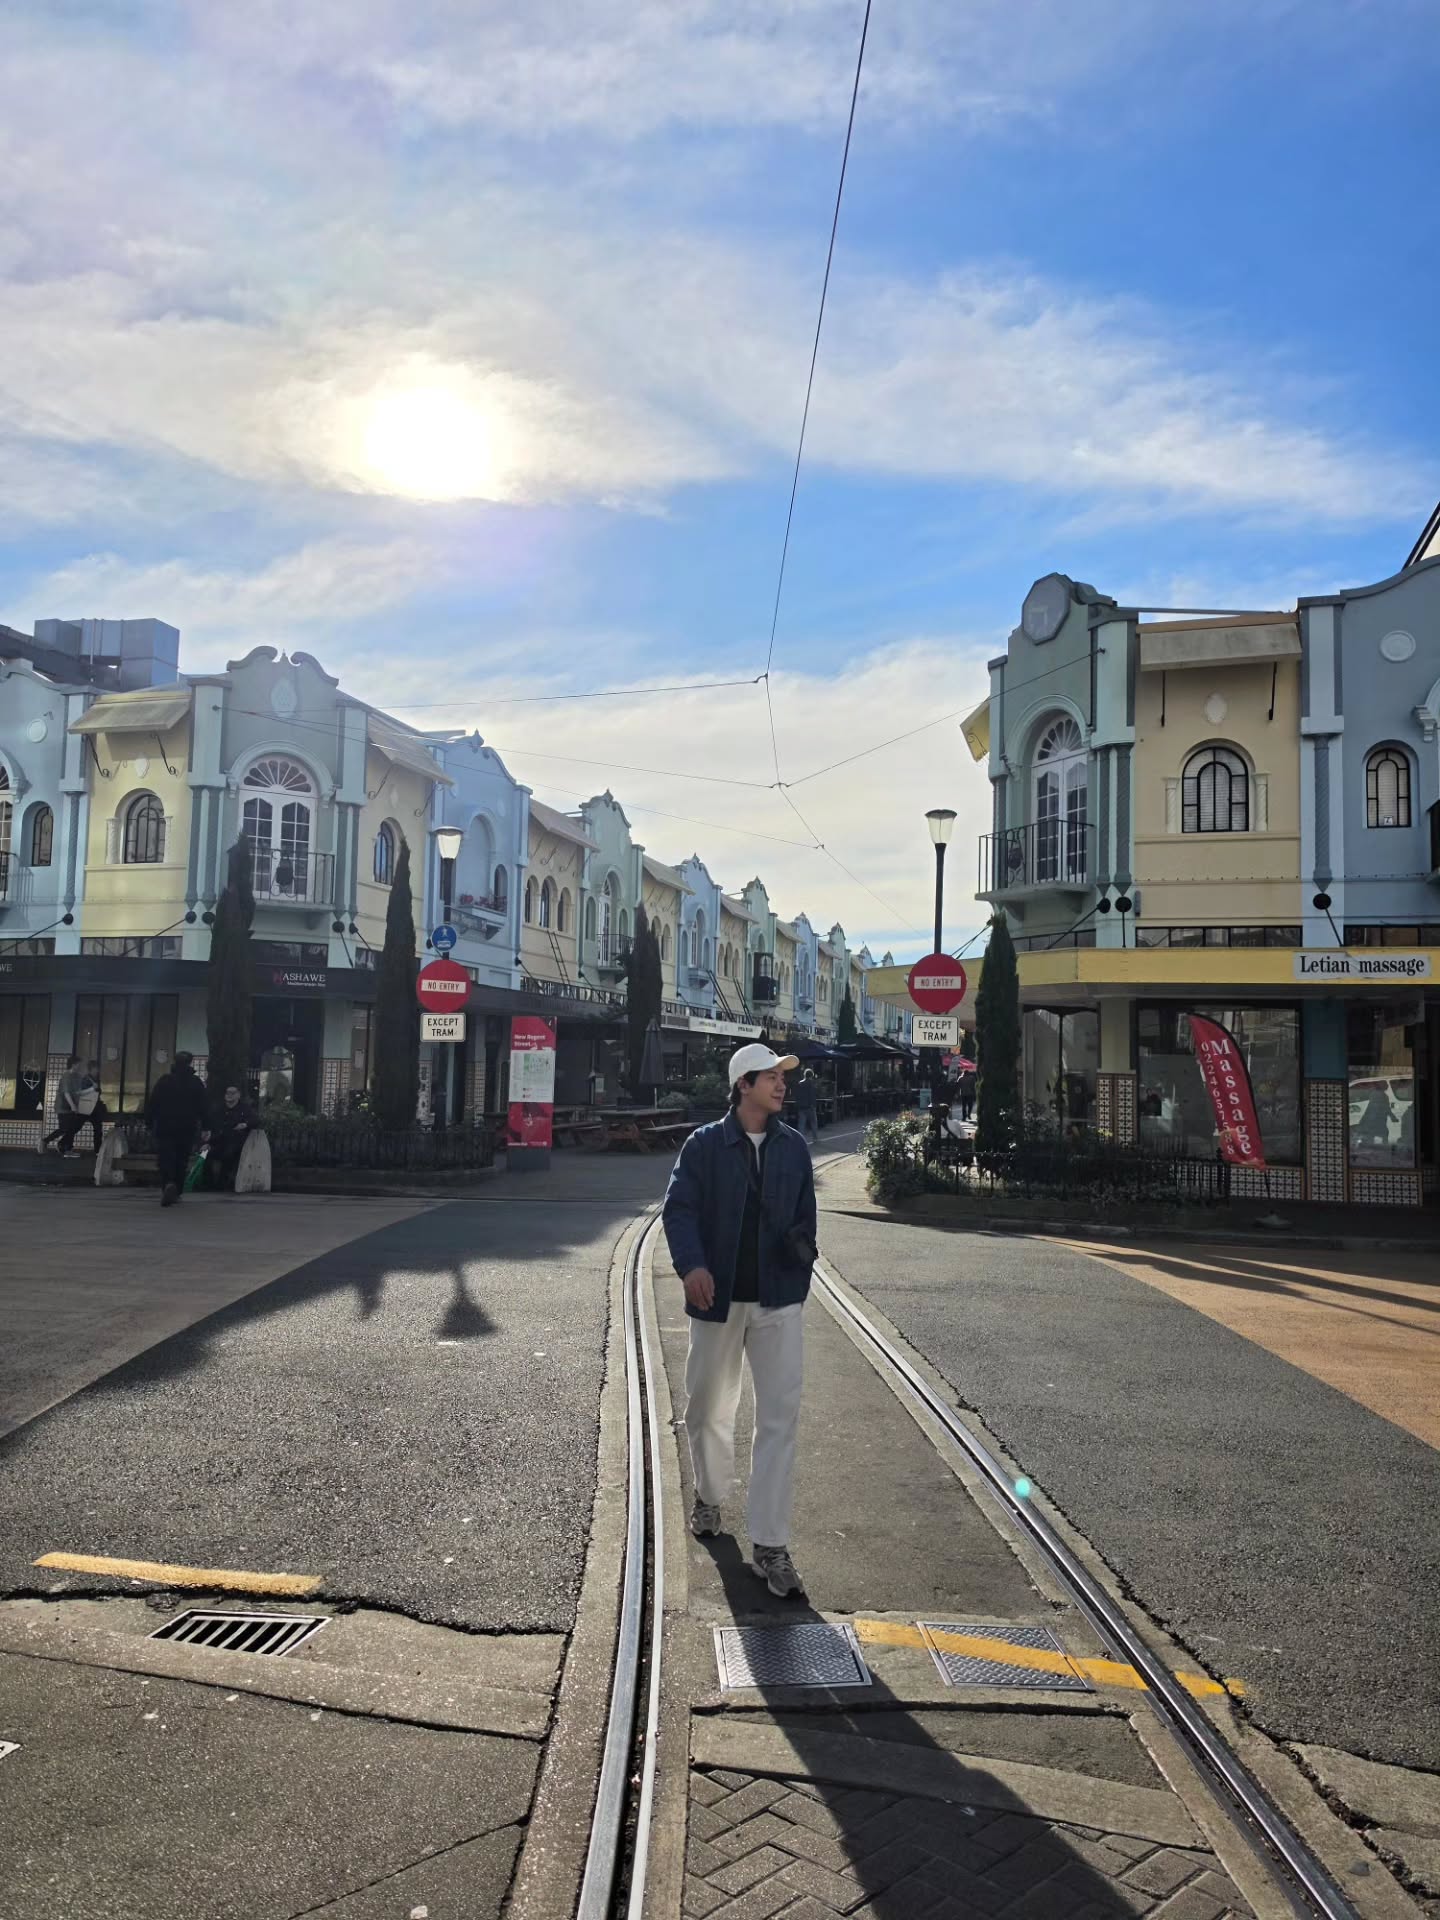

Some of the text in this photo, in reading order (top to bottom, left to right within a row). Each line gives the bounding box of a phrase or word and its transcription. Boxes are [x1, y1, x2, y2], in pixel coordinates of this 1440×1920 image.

[1300, 955, 1425, 976] Letian massage
[427, 981, 460, 992] NO ENTRY
[920, 978, 954, 988] NO ENTRY
[427, 1017, 459, 1027] EXCEPT
[918, 1019, 952, 1030] EXCEPT
[431, 1028, 454, 1037] TRAM
[922, 1031, 948, 1041] TRAM
[1211, 1038, 1253, 1155] Massage
